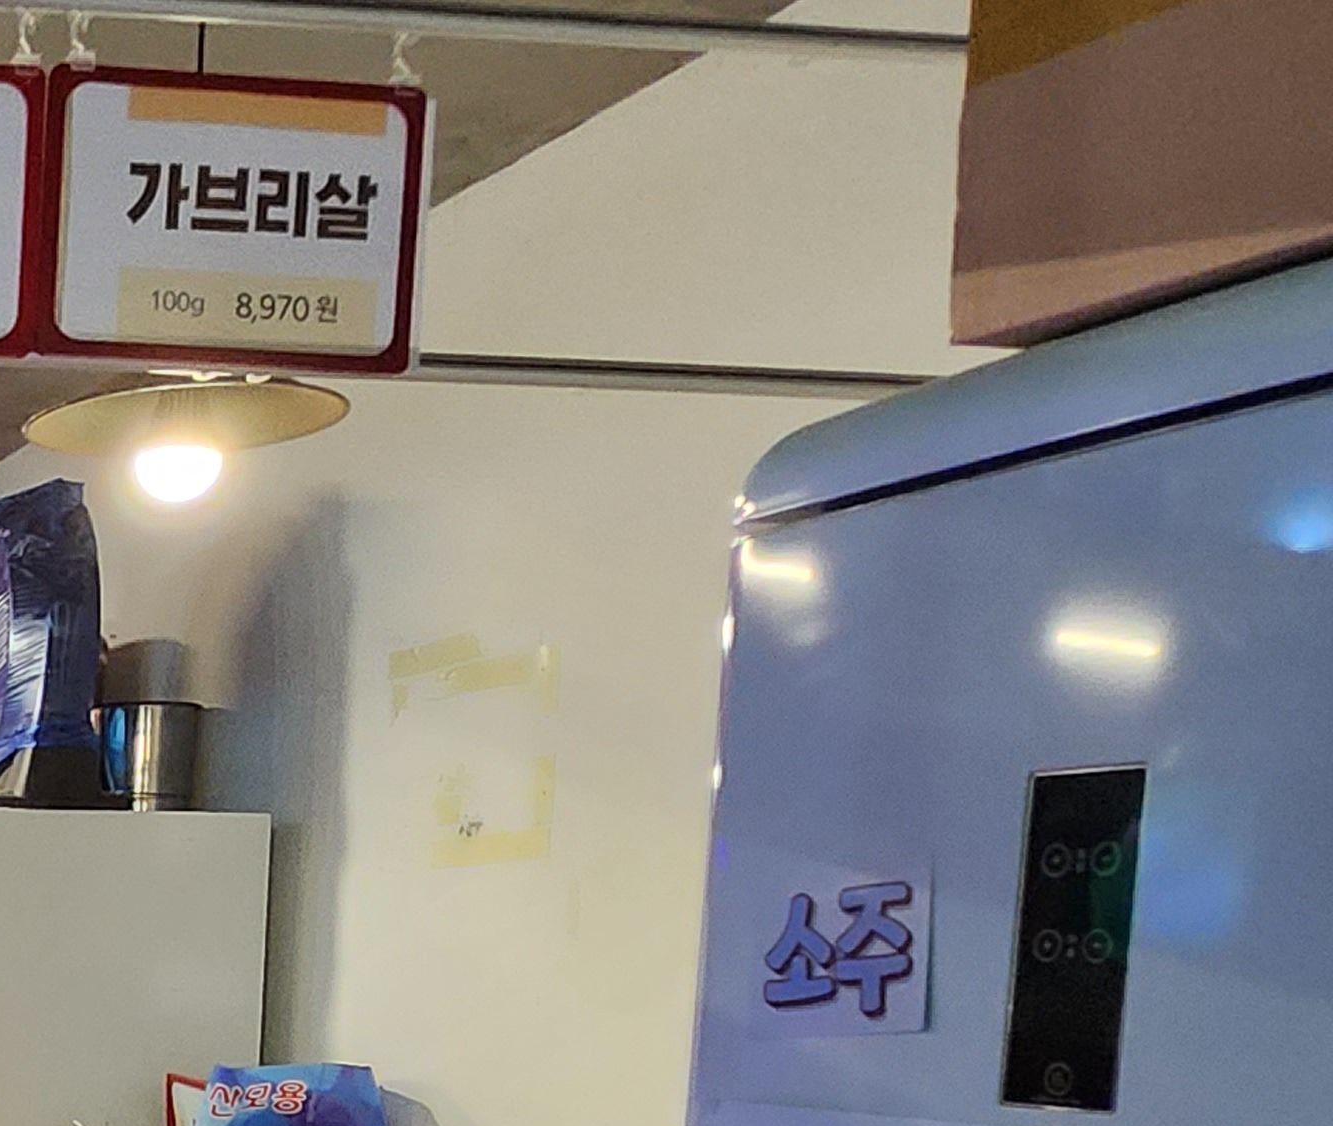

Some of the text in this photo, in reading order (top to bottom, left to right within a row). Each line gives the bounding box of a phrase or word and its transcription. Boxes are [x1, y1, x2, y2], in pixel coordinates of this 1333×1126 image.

[126, 161, 378, 241] 가브리살
[151, 289, 205, 317] 100g
[762, 882, 914, 1020] 소주
